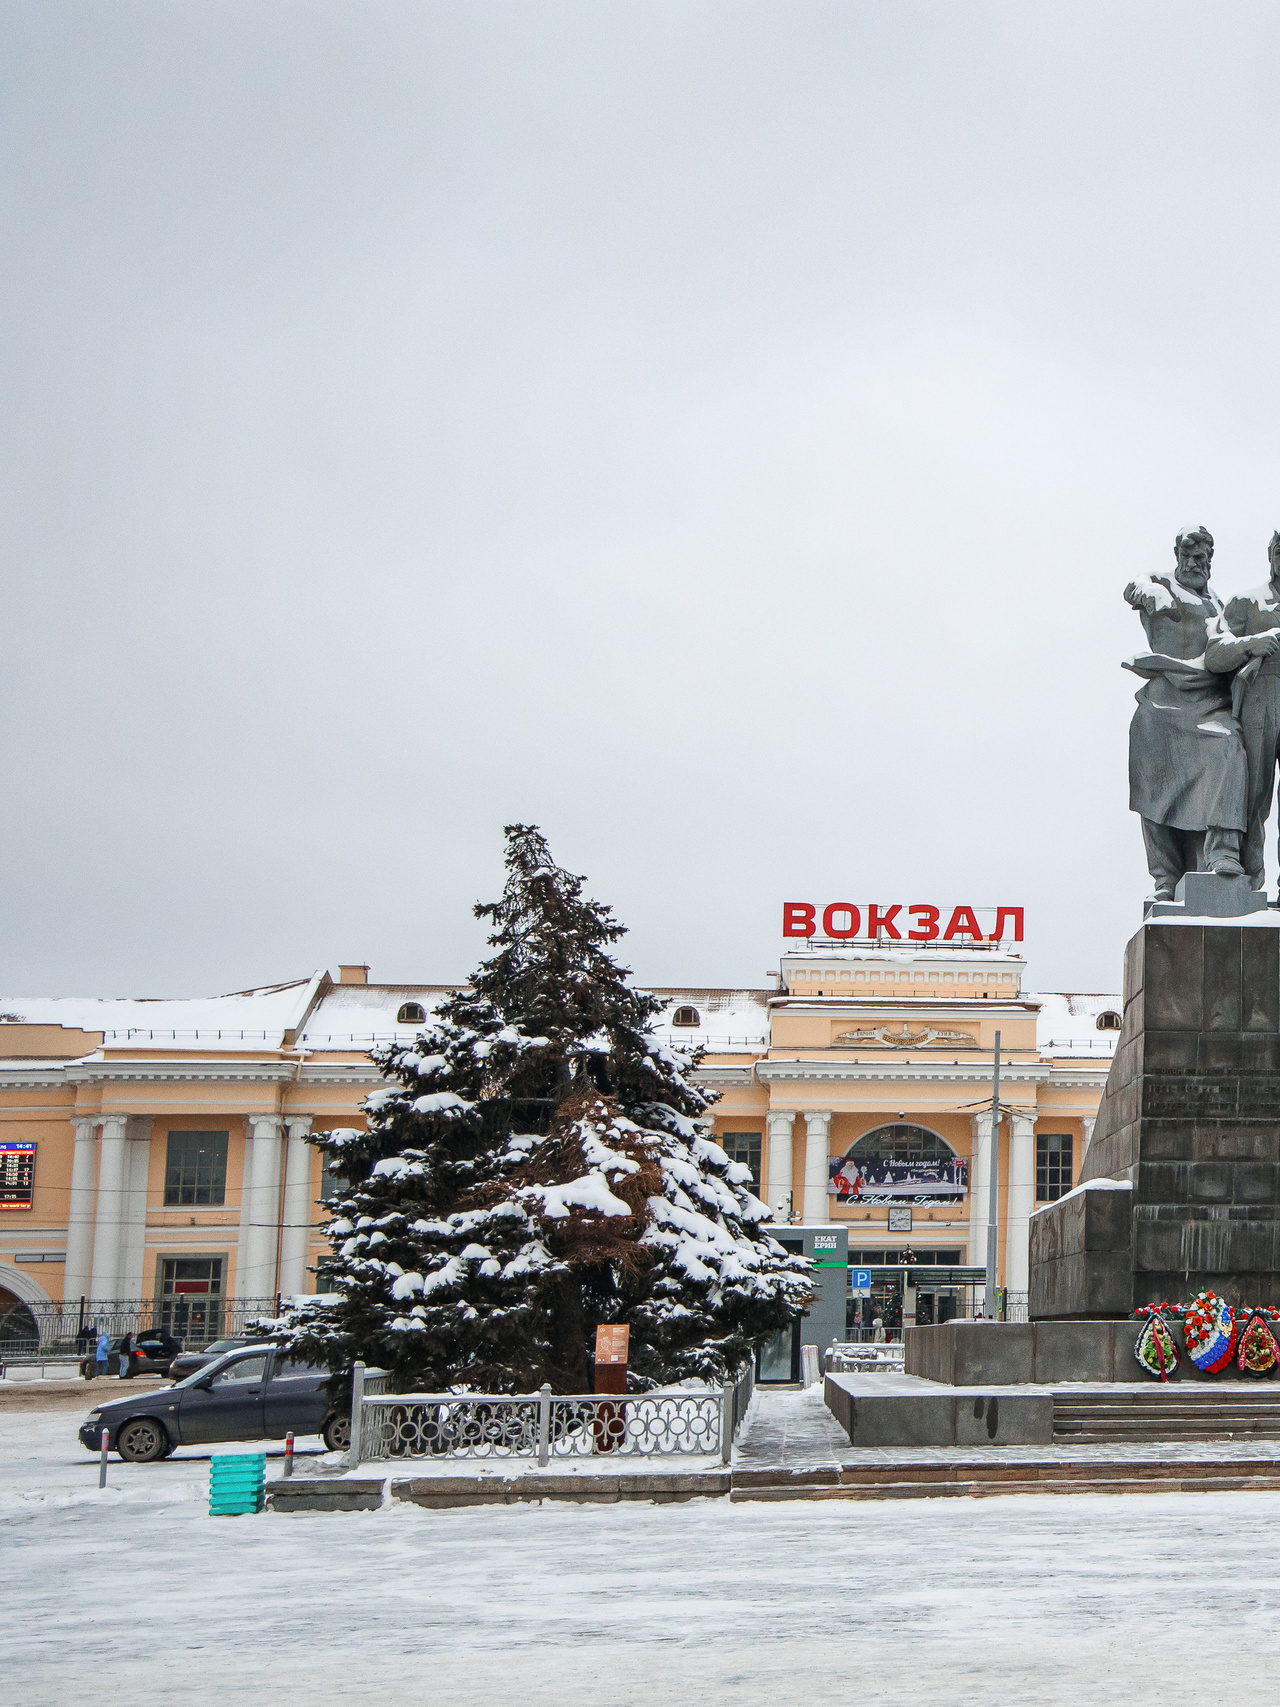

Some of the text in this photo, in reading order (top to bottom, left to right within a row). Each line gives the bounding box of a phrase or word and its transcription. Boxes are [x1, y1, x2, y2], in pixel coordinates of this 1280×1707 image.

[783, 902, 1024, 941] ВОКЗАЛ
[890, 1159, 915, 1168] Новым
[915, 1159, 941, 1169] годом!
[845, 1194, 859, 1207] С
[860, 1194, 908, 1207] Новым
[857, 1272, 868, 1287] P
